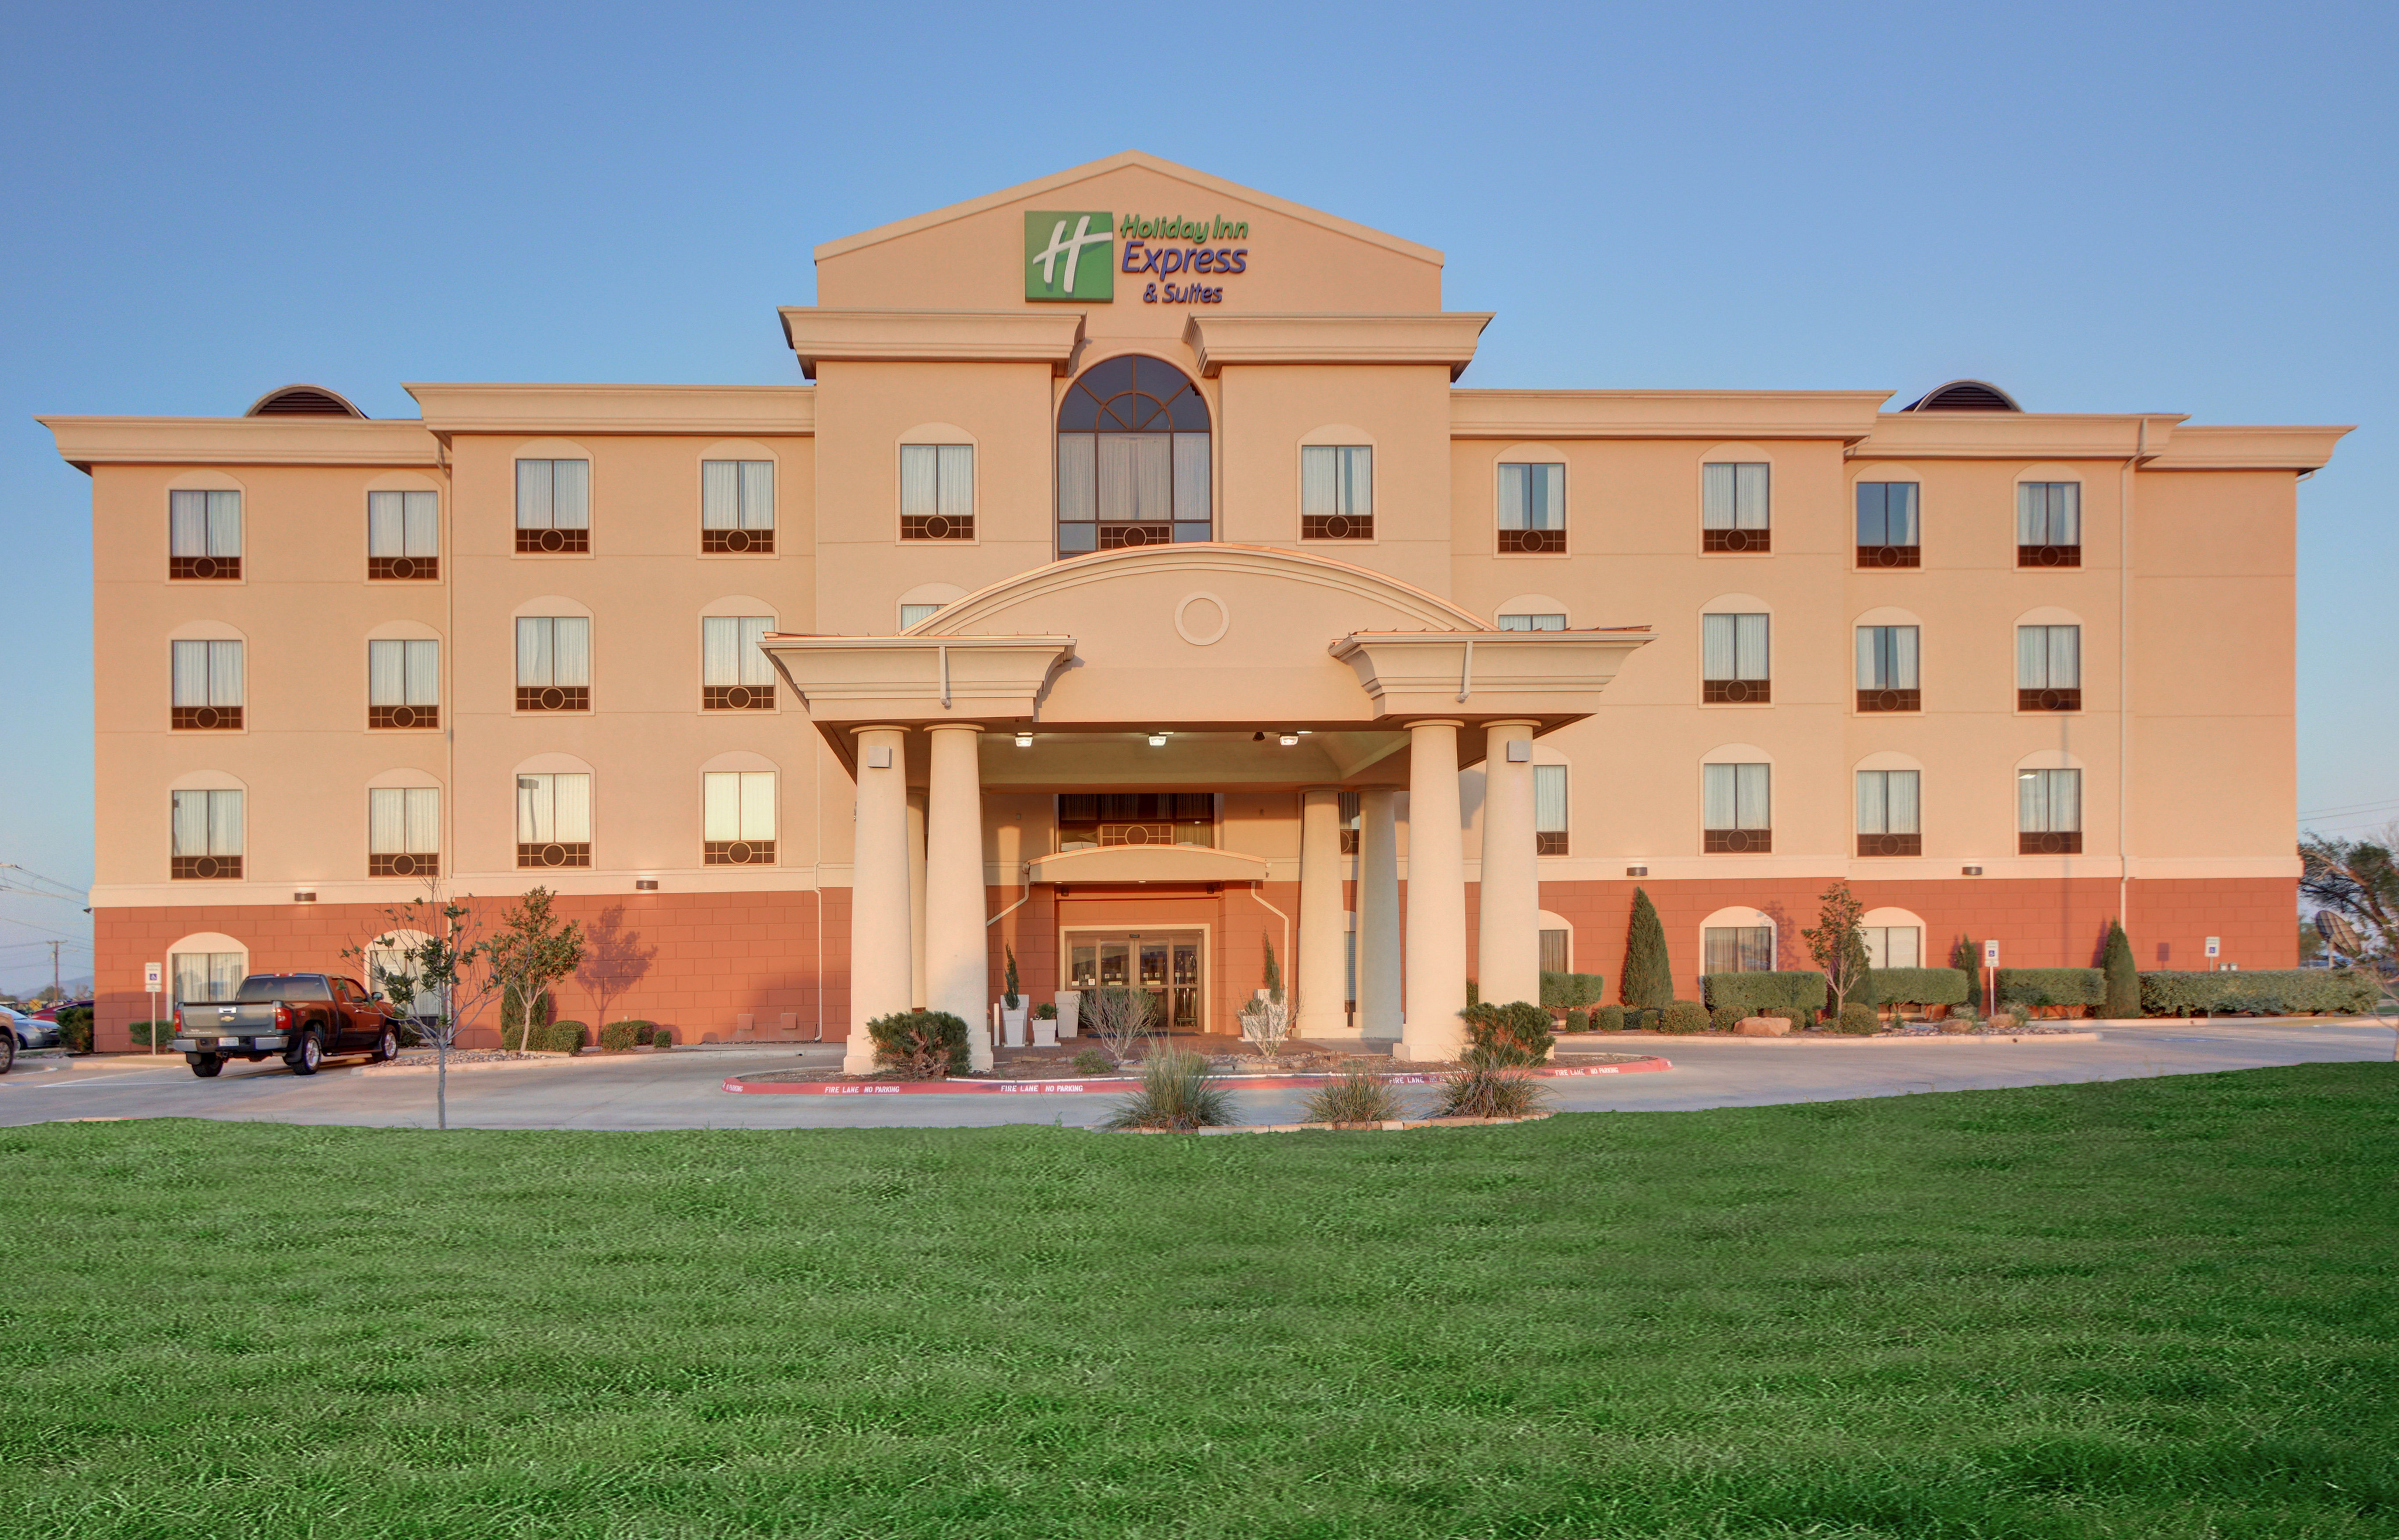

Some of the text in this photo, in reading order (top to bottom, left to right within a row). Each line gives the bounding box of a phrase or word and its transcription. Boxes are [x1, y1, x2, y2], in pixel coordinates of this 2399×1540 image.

[1120, 214, 1248, 244] Holiday Inn
[1122, 240, 1248, 281] Express
[1143, 282, 1223, 303] & Suites
